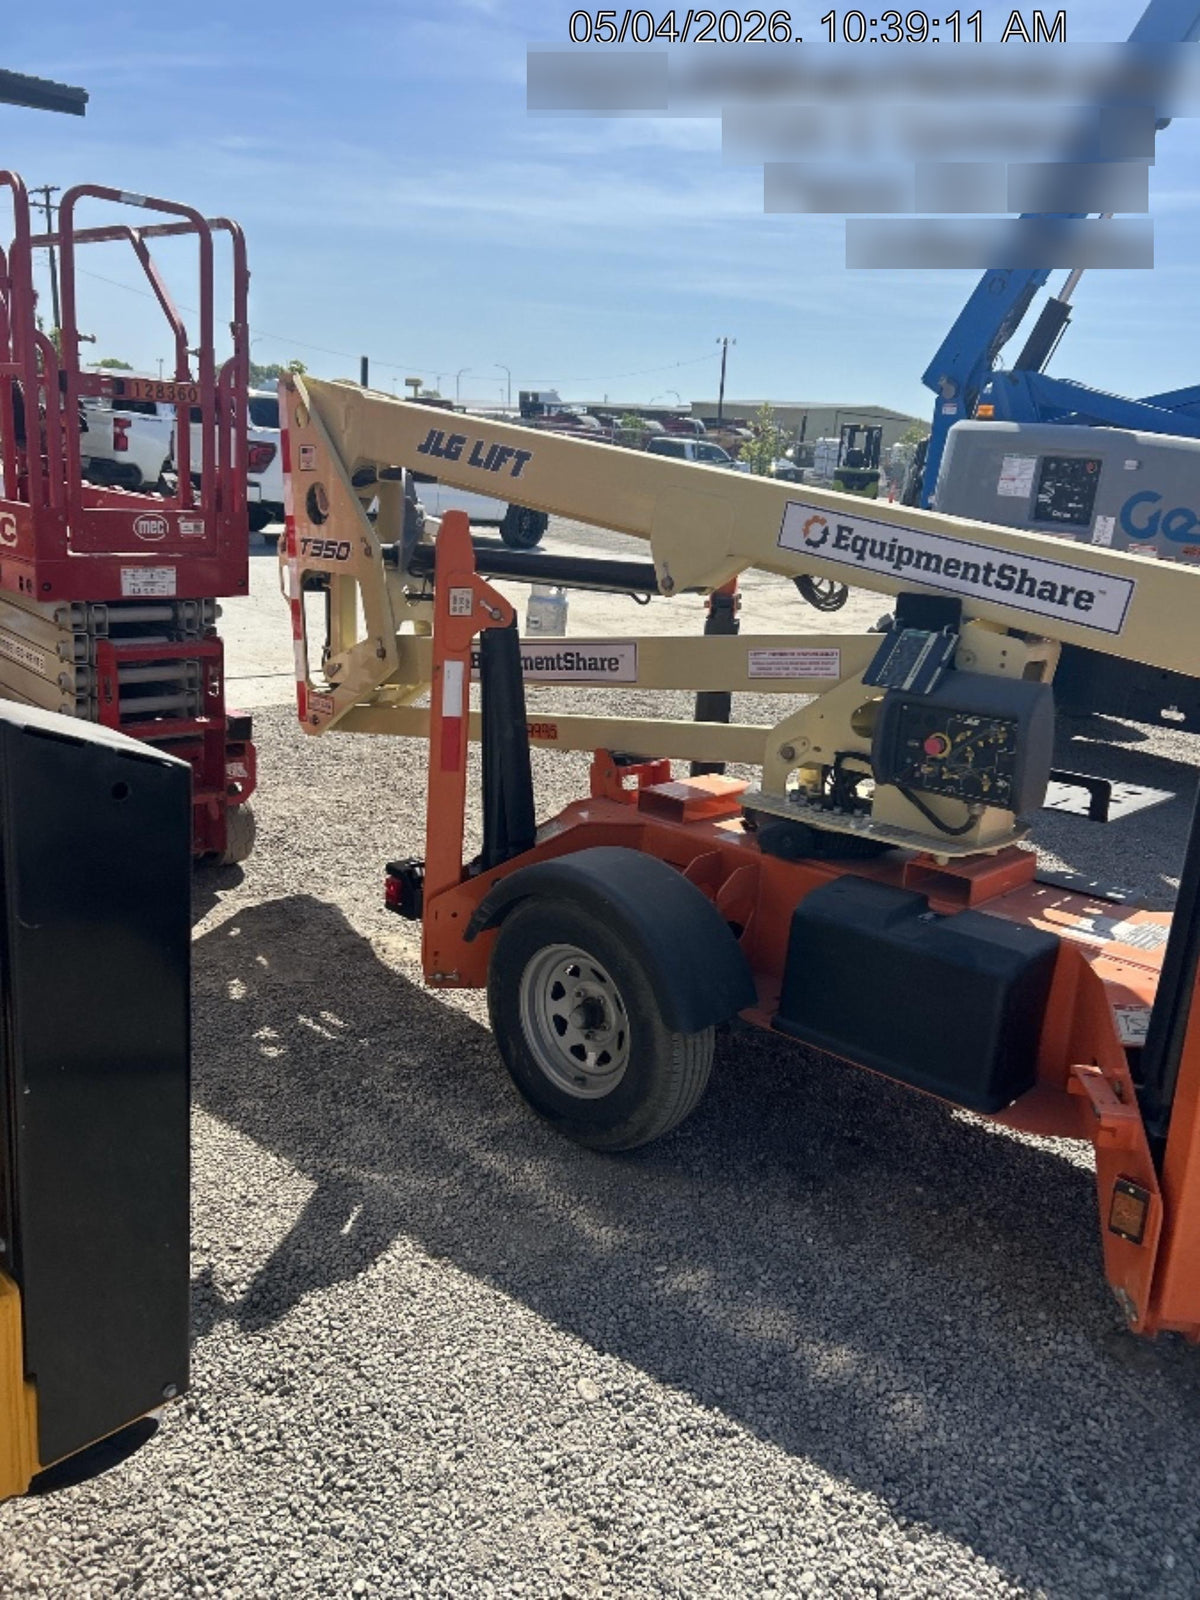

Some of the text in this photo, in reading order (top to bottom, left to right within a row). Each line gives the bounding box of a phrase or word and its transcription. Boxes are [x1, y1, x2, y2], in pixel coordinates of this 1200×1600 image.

[134, 381, 198, 403] 128360
[416, 427, 534, 479] JLG LIFT
[300, 536, 352, 561] T350
[831, 522, 1098, 613] EquipmentShare
